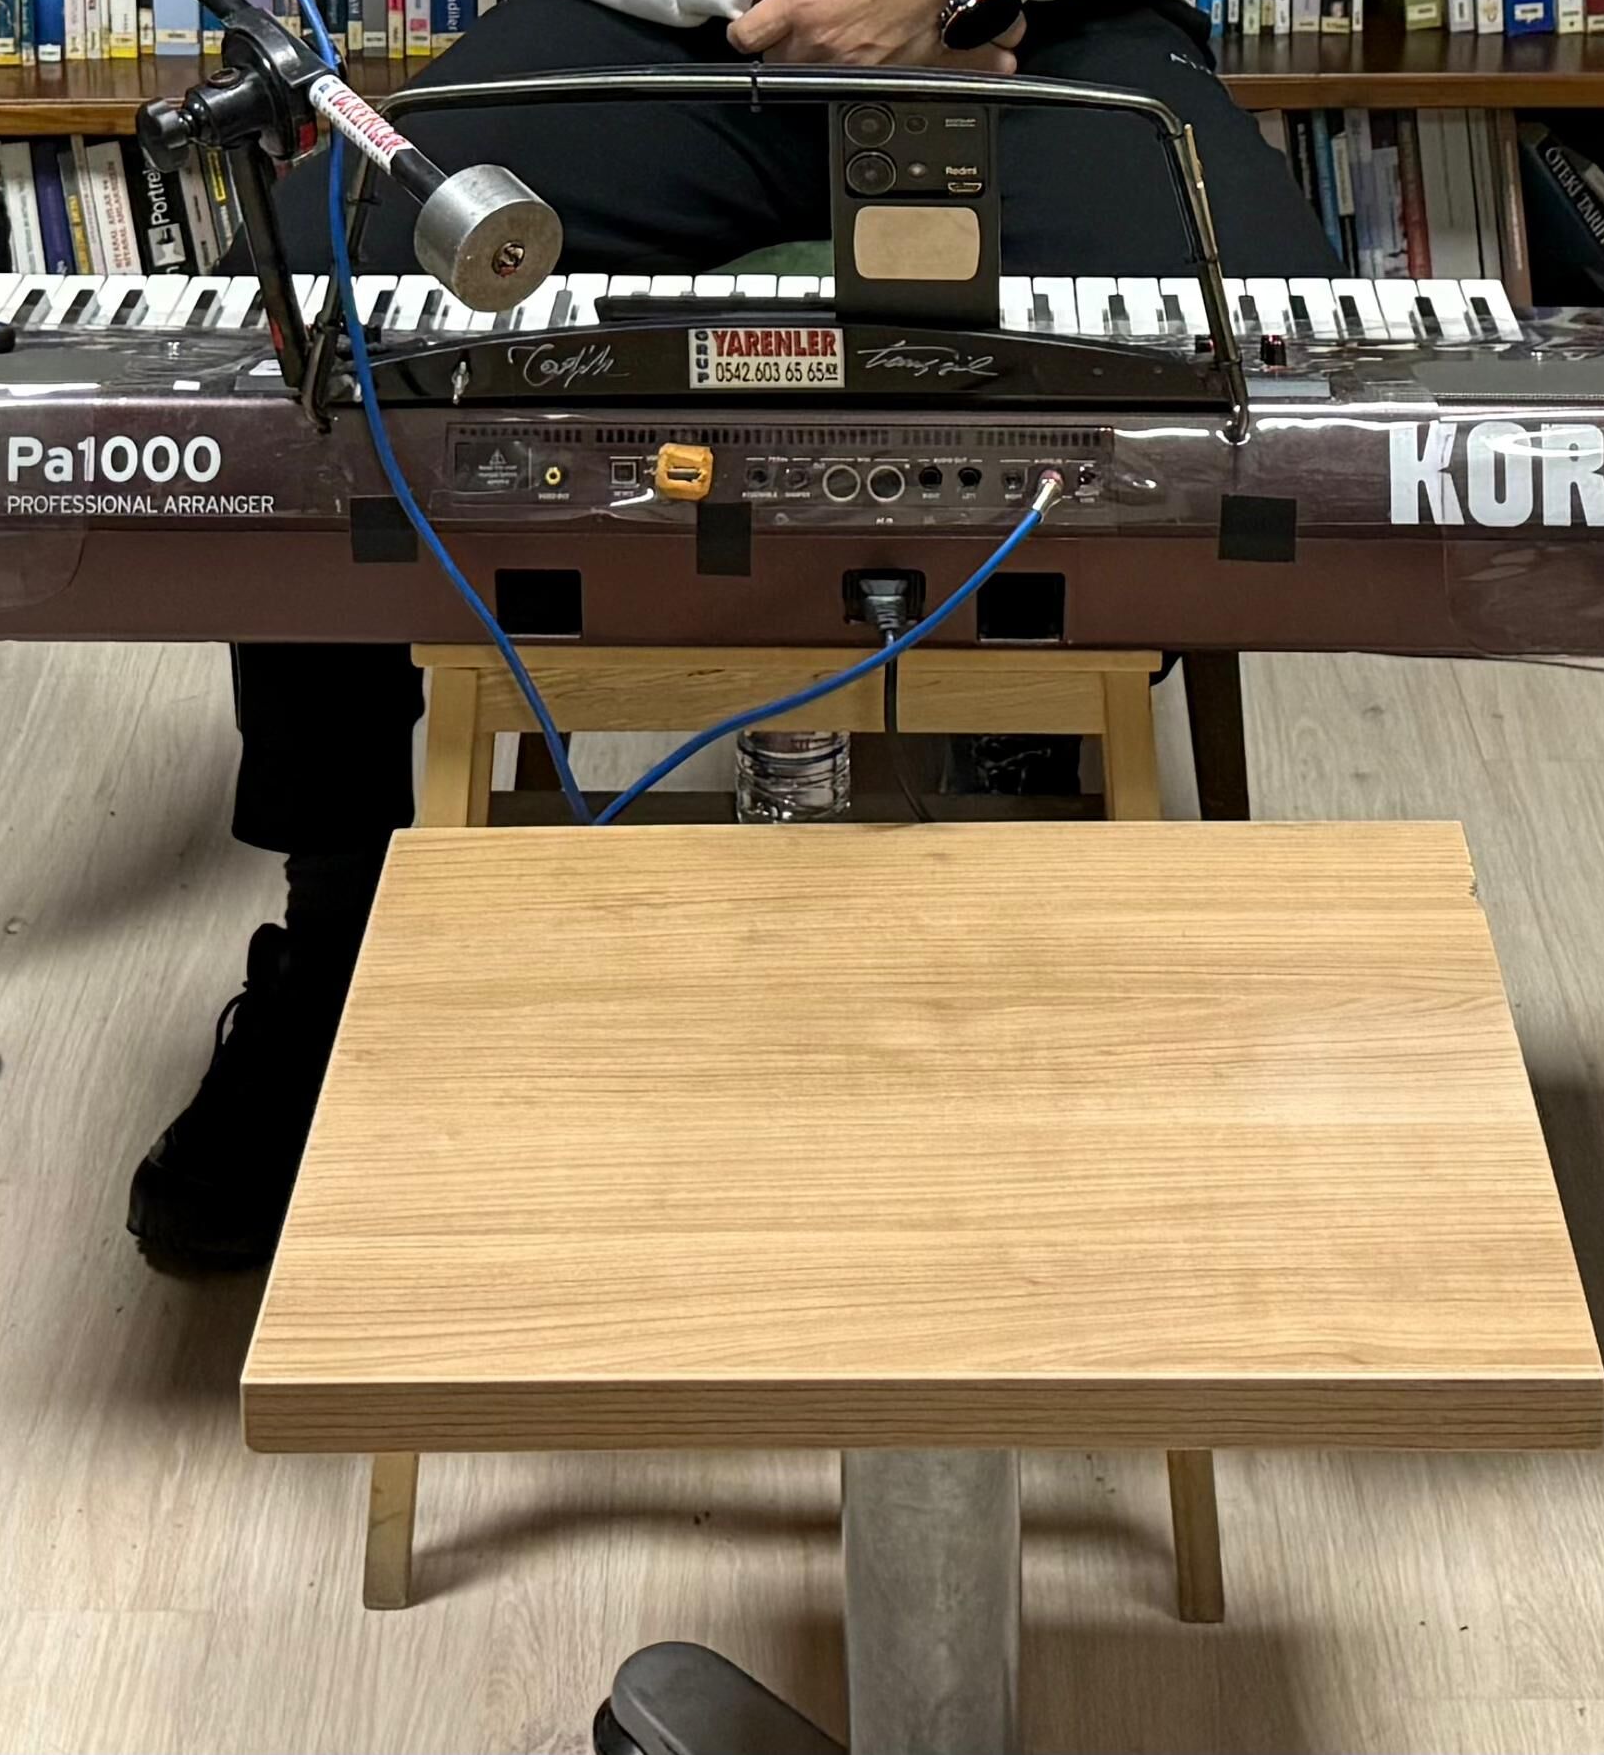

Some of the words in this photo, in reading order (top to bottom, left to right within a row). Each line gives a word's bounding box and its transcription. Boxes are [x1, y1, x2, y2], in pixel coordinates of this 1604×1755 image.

[945, 165, 978, 176] Redmi
[1544, 145, 1587, 198] ÖTEKİ
[712, 329, 840, 358] YARENLER
[714, 360, 783, 384] 0542.603
[785, 360, 805, 384] 65
[808, 360, 825, 384] 65
[6, 434, 222, 484] Pa1000
[6, 493, 159, 515] PROFESSIONAL
[162, 493, 276, 516] ARRANGER
